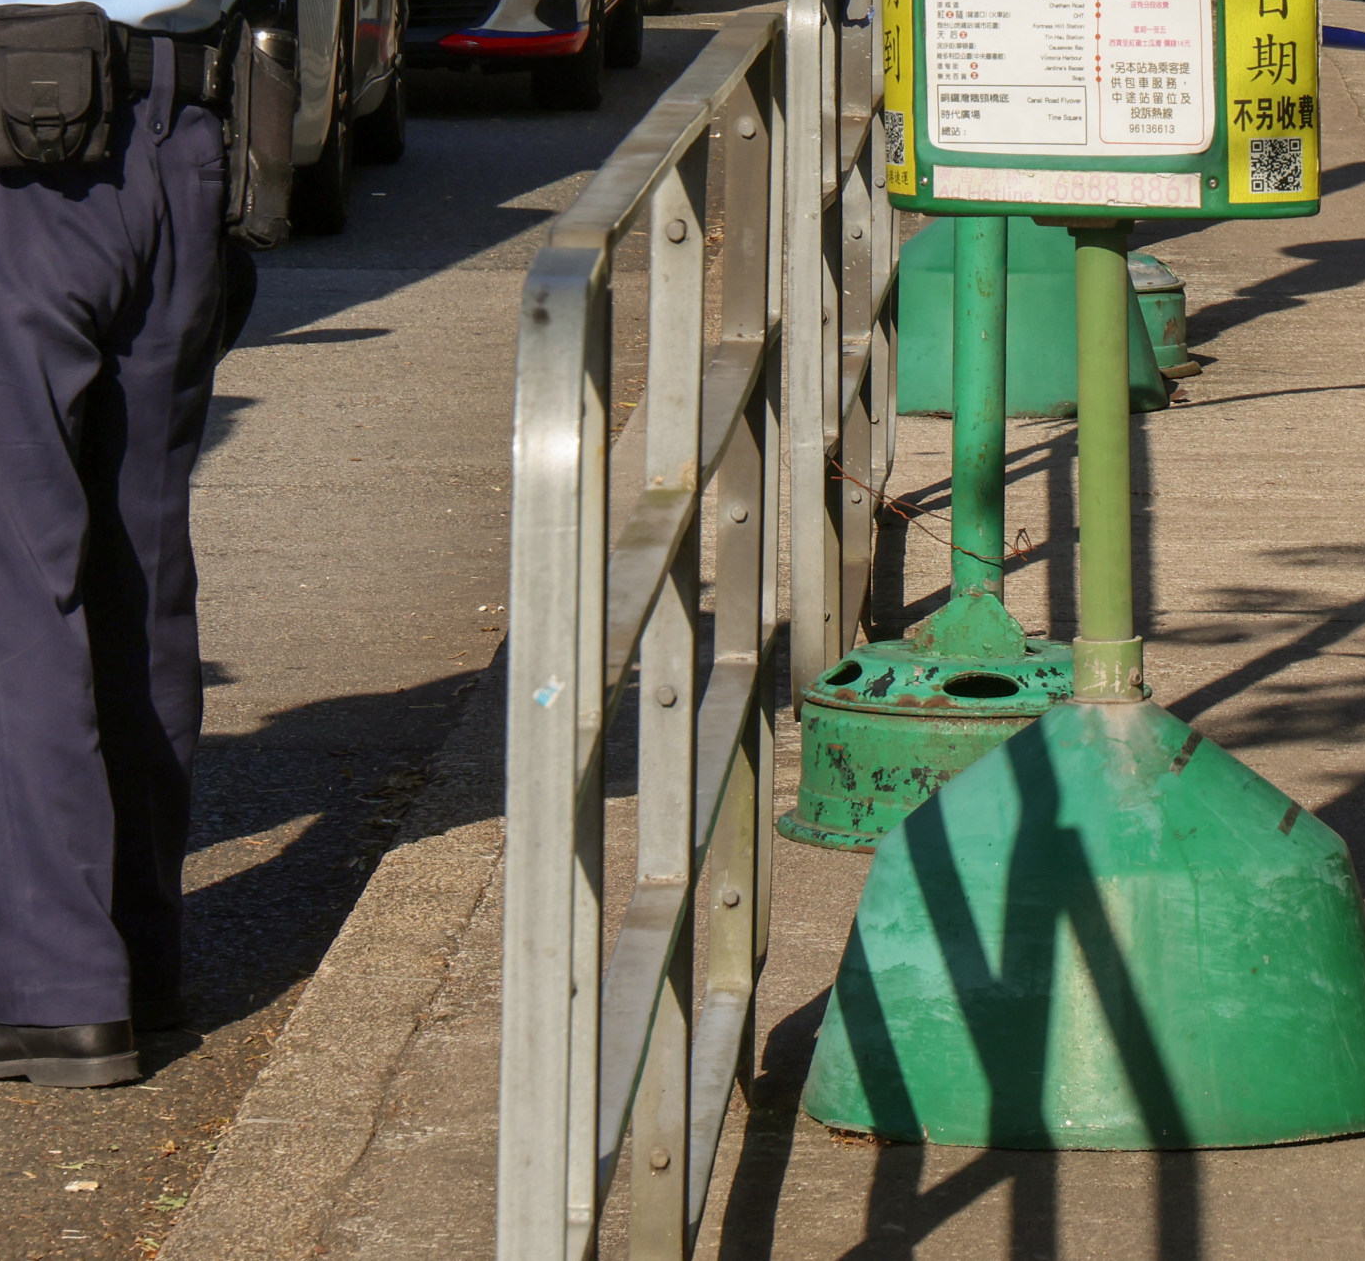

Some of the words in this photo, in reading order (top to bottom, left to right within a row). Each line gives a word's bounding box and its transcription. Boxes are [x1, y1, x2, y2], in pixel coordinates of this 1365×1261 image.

[940, 110, 980, 119] 時代廣場
[1131, 107, 1173, 119] 投訴熱線
[1233, 95, 1315, 132] 不另收費
[1129, 124, 1175, 134] 96136613
[1054, 174, 1120, 202] 6888
[1132, 175, 1194, 203] 8861
